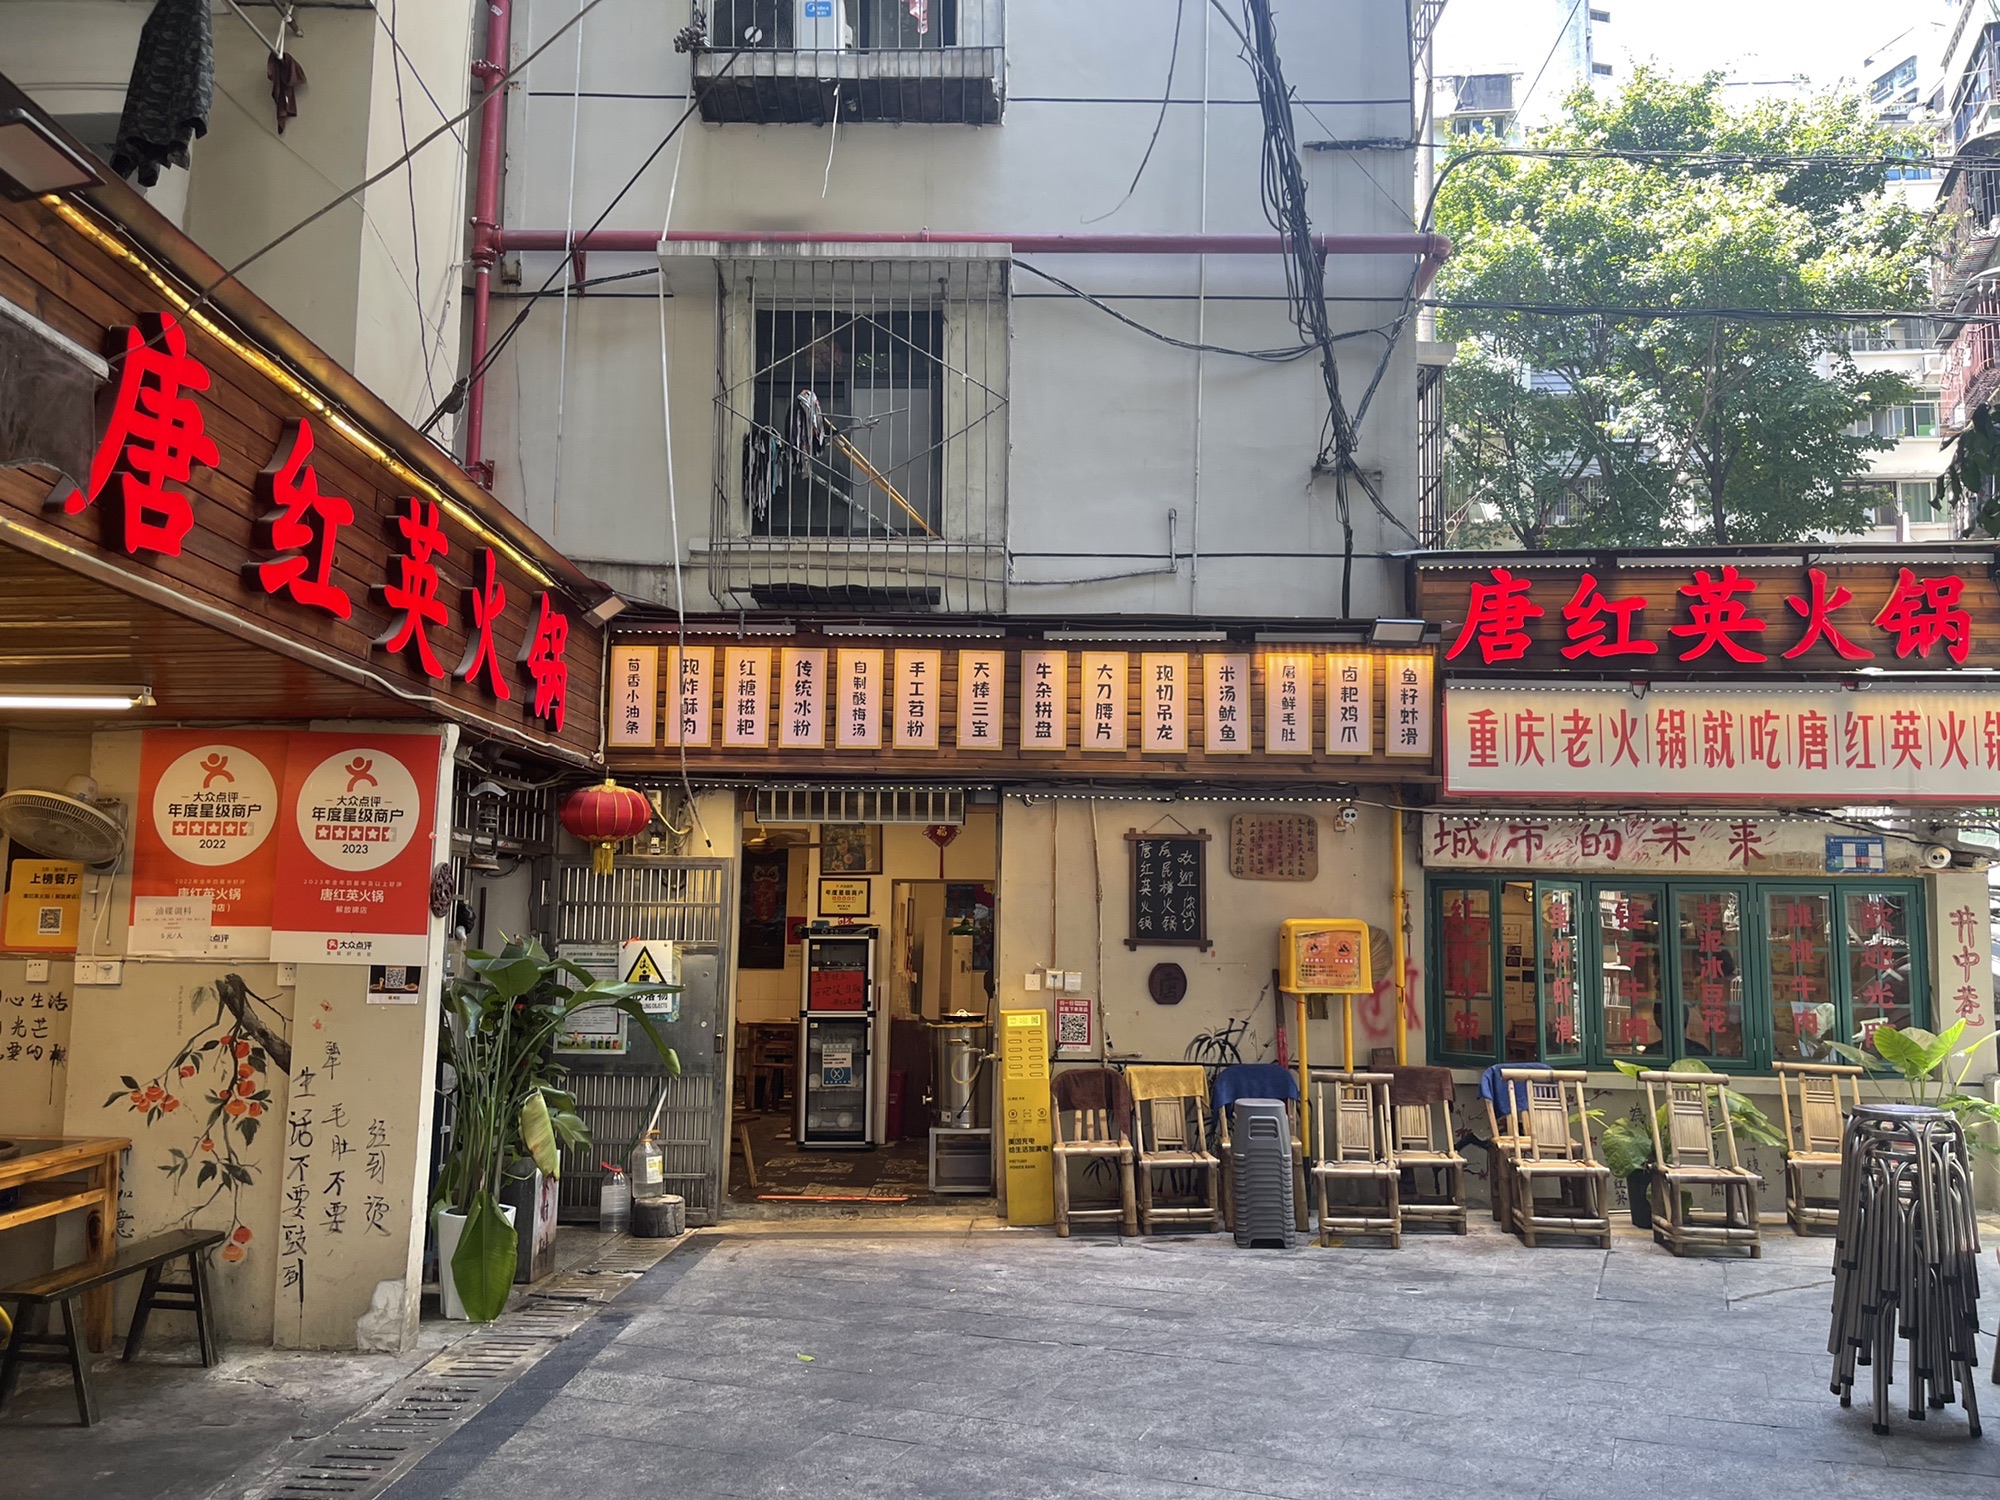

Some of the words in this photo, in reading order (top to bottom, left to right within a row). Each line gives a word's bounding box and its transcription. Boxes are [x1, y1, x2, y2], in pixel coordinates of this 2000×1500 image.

[65, 311, 568, 733] 唐红英火锅
[1444, 564, 1974, 666] 唐红英火锅
[625, 658, 641, 735] 茴香小油条
[681, 658, 700, 736] 现炸酥肉
[736, 659, 757, 736] 红糖糍粑
[792, 659, 813, 738] 传统冰粉
[852, 661, 868, 738] 自制酸梅汤
[906, 661, 926, 738] 手工苕粉
[972, 661, 990, 738] 天棒三宝
[1034, 662, 1053, 739] 牛杂拼盘
[1095, 663, 1114, 741] 大刀腰片
[1155, 664, 1174, 742] 现切吊龙
[1218, 665, 1237, 743] 米汤鱿鱼
[1281, 665, 1297, 743] 屠场鲜毛肚
[167, 803, 262, 819] 年度星级商户
[193, 791, 239, 803] 大众点评
[311, 806, 405, 824] 年度星级商户
[336, 795, 382, 807] 大众点评
[30, 872, 79, 885] 上榜餐厅
[199, 839, 226, 849] 2022
[342, 843, 369, 854] 2023
[1434, 819, 1767, 866] 城市的未来
[178, 887, 242, 901] 唐红英火锅
[320, 888, 385, 903] 唐红英火锅
[335, 905, 368, 914] 解放碑店
[1137, 840, 1154, 931] 唐红英火锅
[339, 940, 373, 950] 大众点评
[1949, 904, 1985, 1027] 井中巷
[0, 989, 68, 1012] 心生活
[0, 1015, 48, 1039] 光芒
